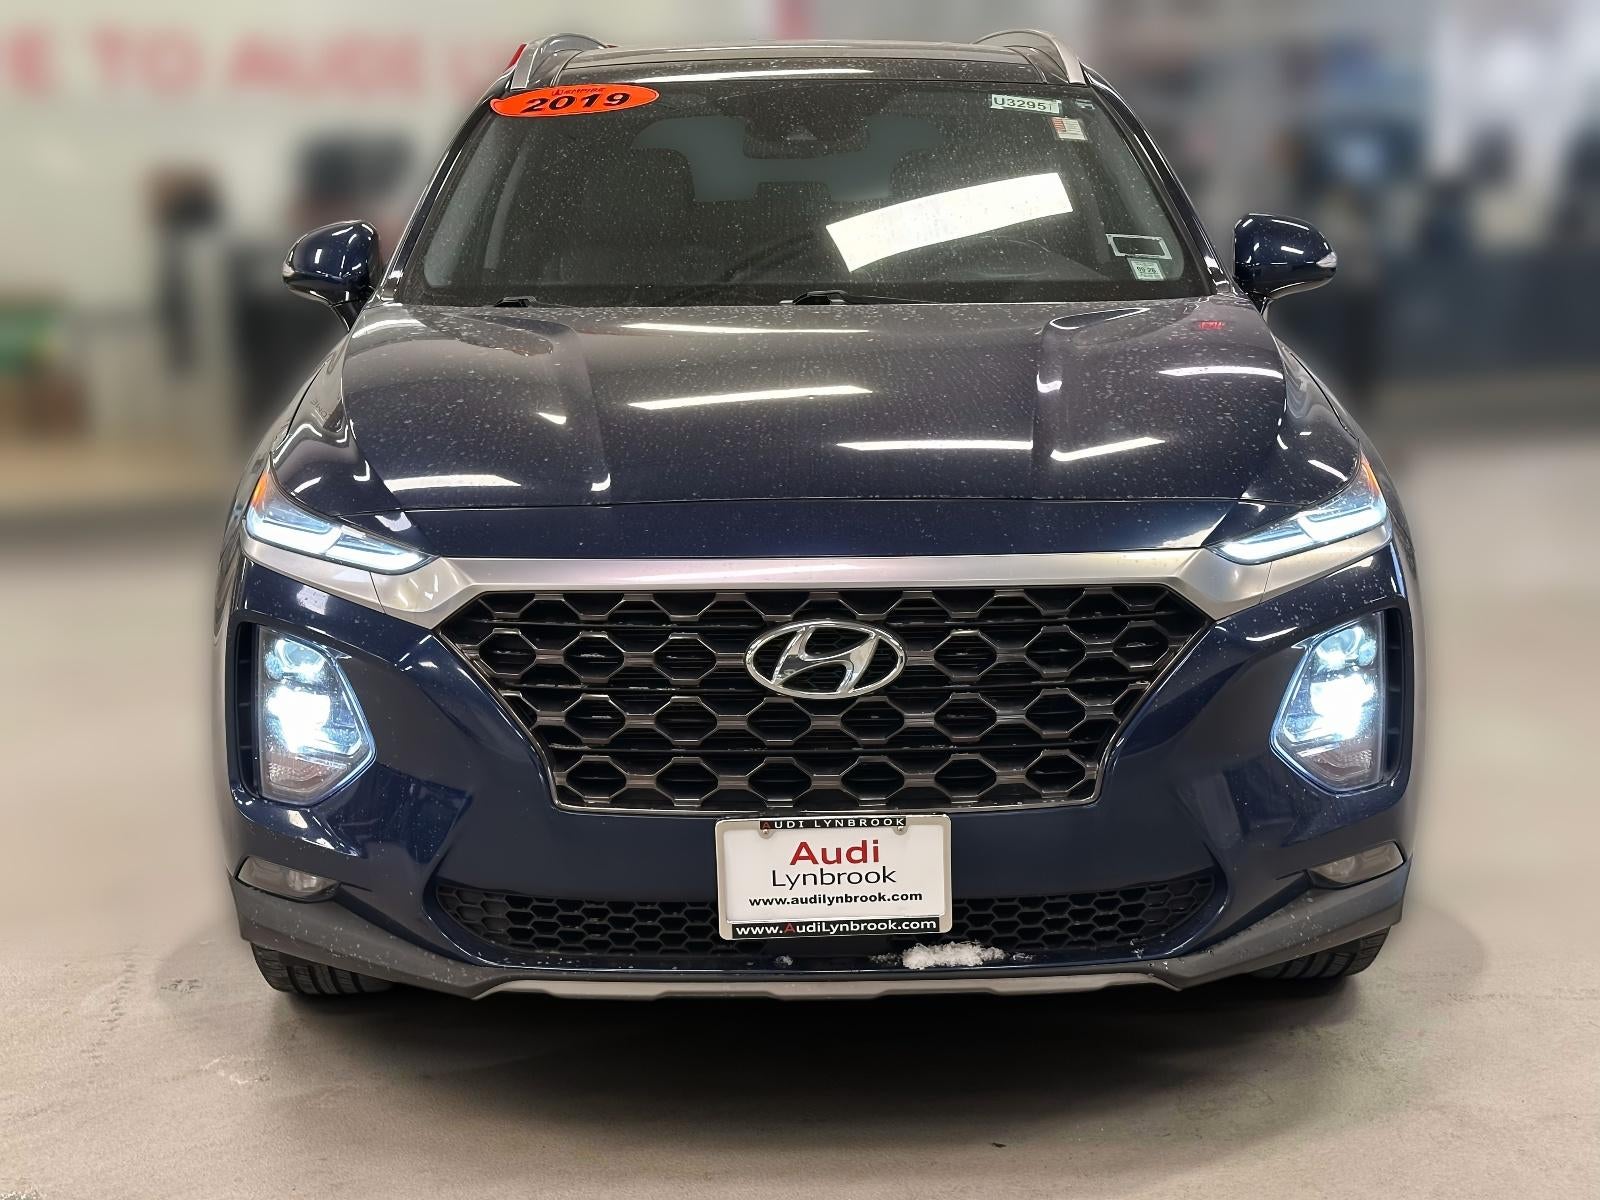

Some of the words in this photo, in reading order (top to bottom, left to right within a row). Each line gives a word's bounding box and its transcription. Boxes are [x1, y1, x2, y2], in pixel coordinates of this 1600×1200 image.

[521, 93, 631, 113] 2019
[762, 820, 805, 830] AUDI
[814, 818, 905, 829] LYNBROOK
[790, 839, 880, 866] Audi
[772, 866, 897, 890] Lynbrook
[749, 892, 923, 906] www.audilynbrook.com
[736, 919, 937, 935] www.AudiLynbrook.com
